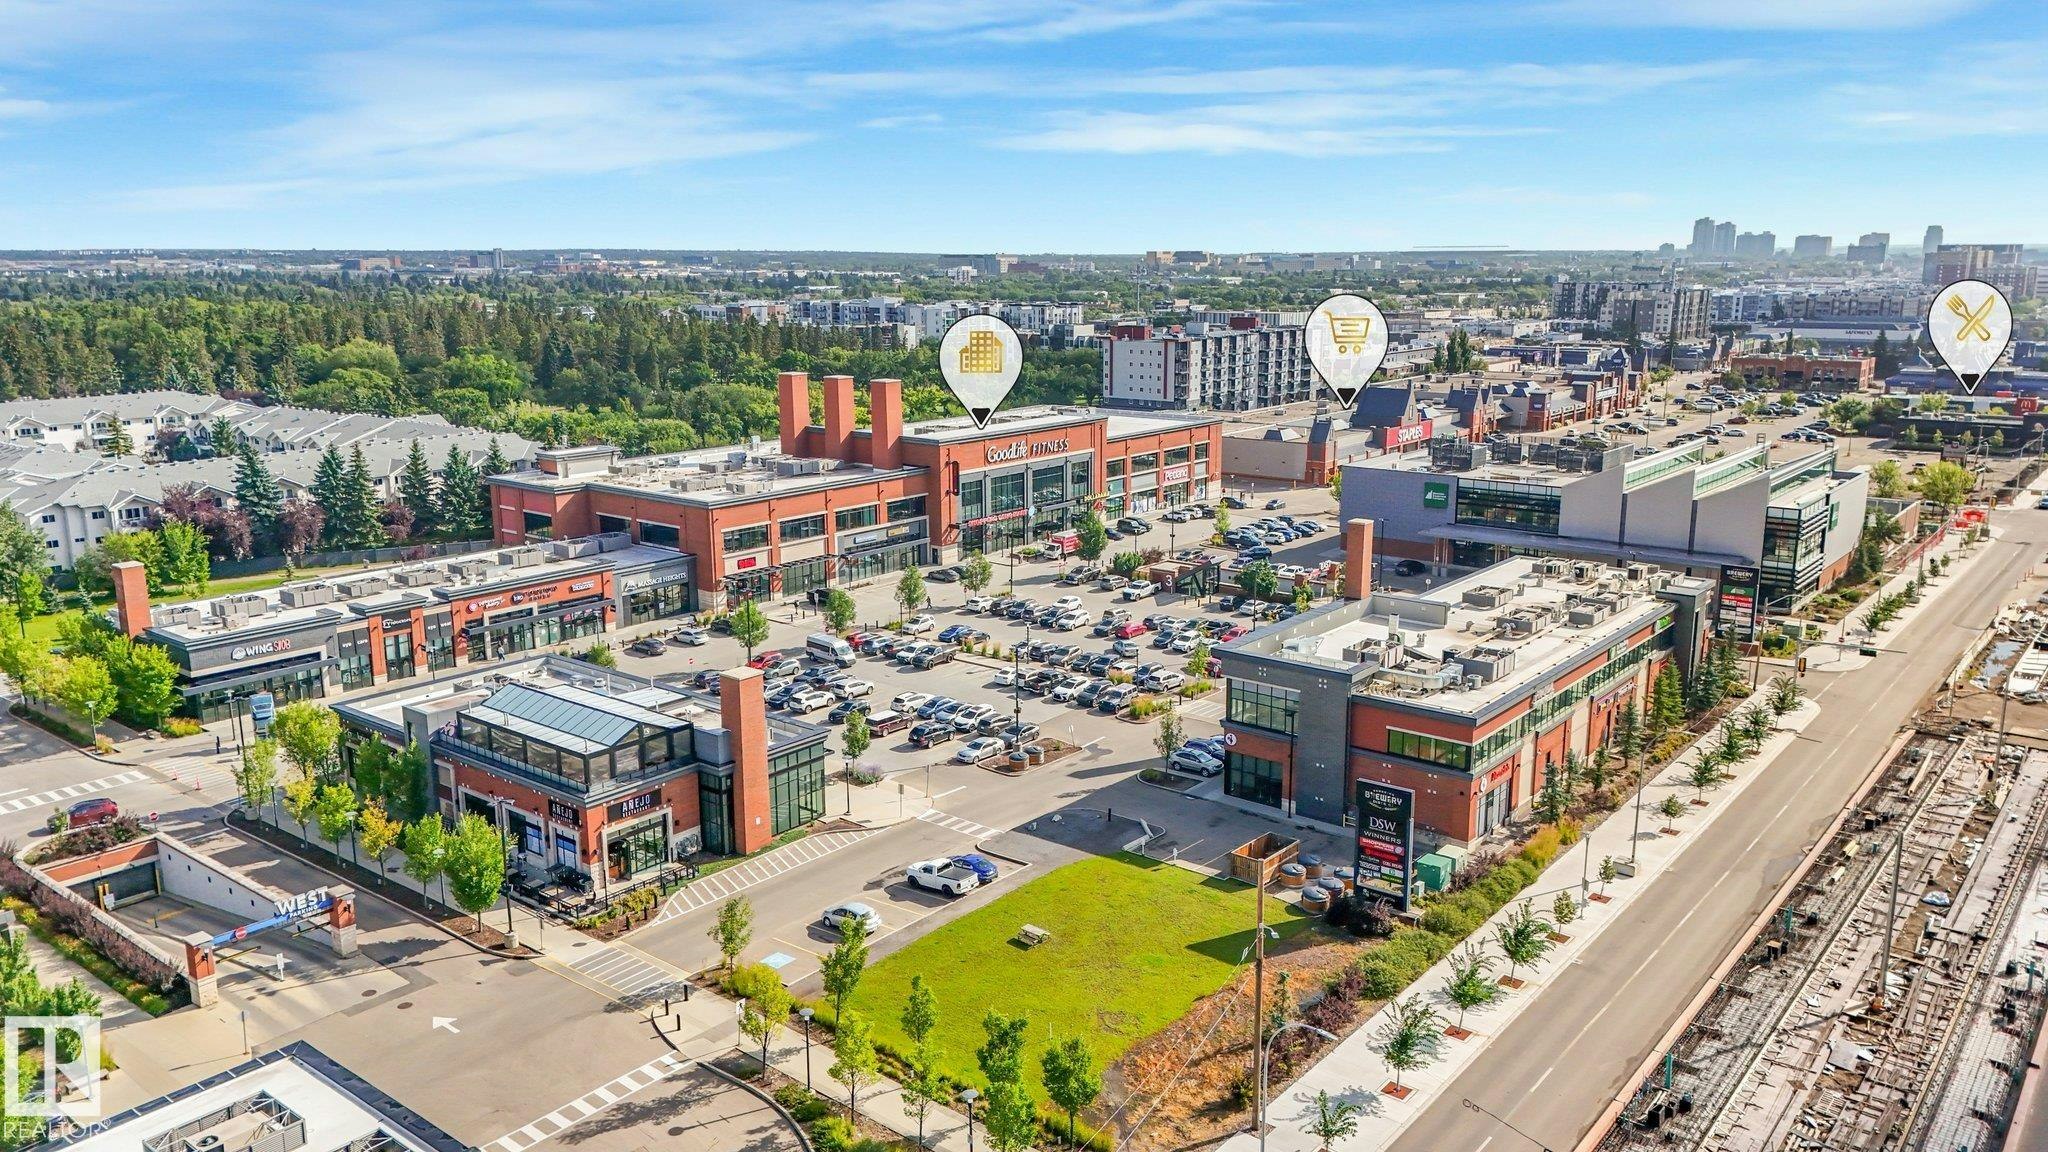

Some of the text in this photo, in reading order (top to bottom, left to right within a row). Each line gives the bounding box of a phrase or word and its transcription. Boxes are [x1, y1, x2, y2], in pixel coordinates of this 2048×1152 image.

[1398, 425, 1424, 443] STAPLES
[987, 438, 1069, 463] GoodLife FITNESS
[1165, 467, 1189, 481] Petland
[637, 571, 687, 588] MASSAGE HEIGHTS
[1165, 574, 1173, 587] 3
[245, 643, 273, 656] WING
[552, 803, 573, 820] AÑEJO
[622, 794, 651, 813] AÑEJO
[1369, 816, 1397, 832] DSW
[1363, 830, 1402, 845] WINNERS
[274, 885, 329, 915] WEST
[289, 904, 319, 918] PARKING
